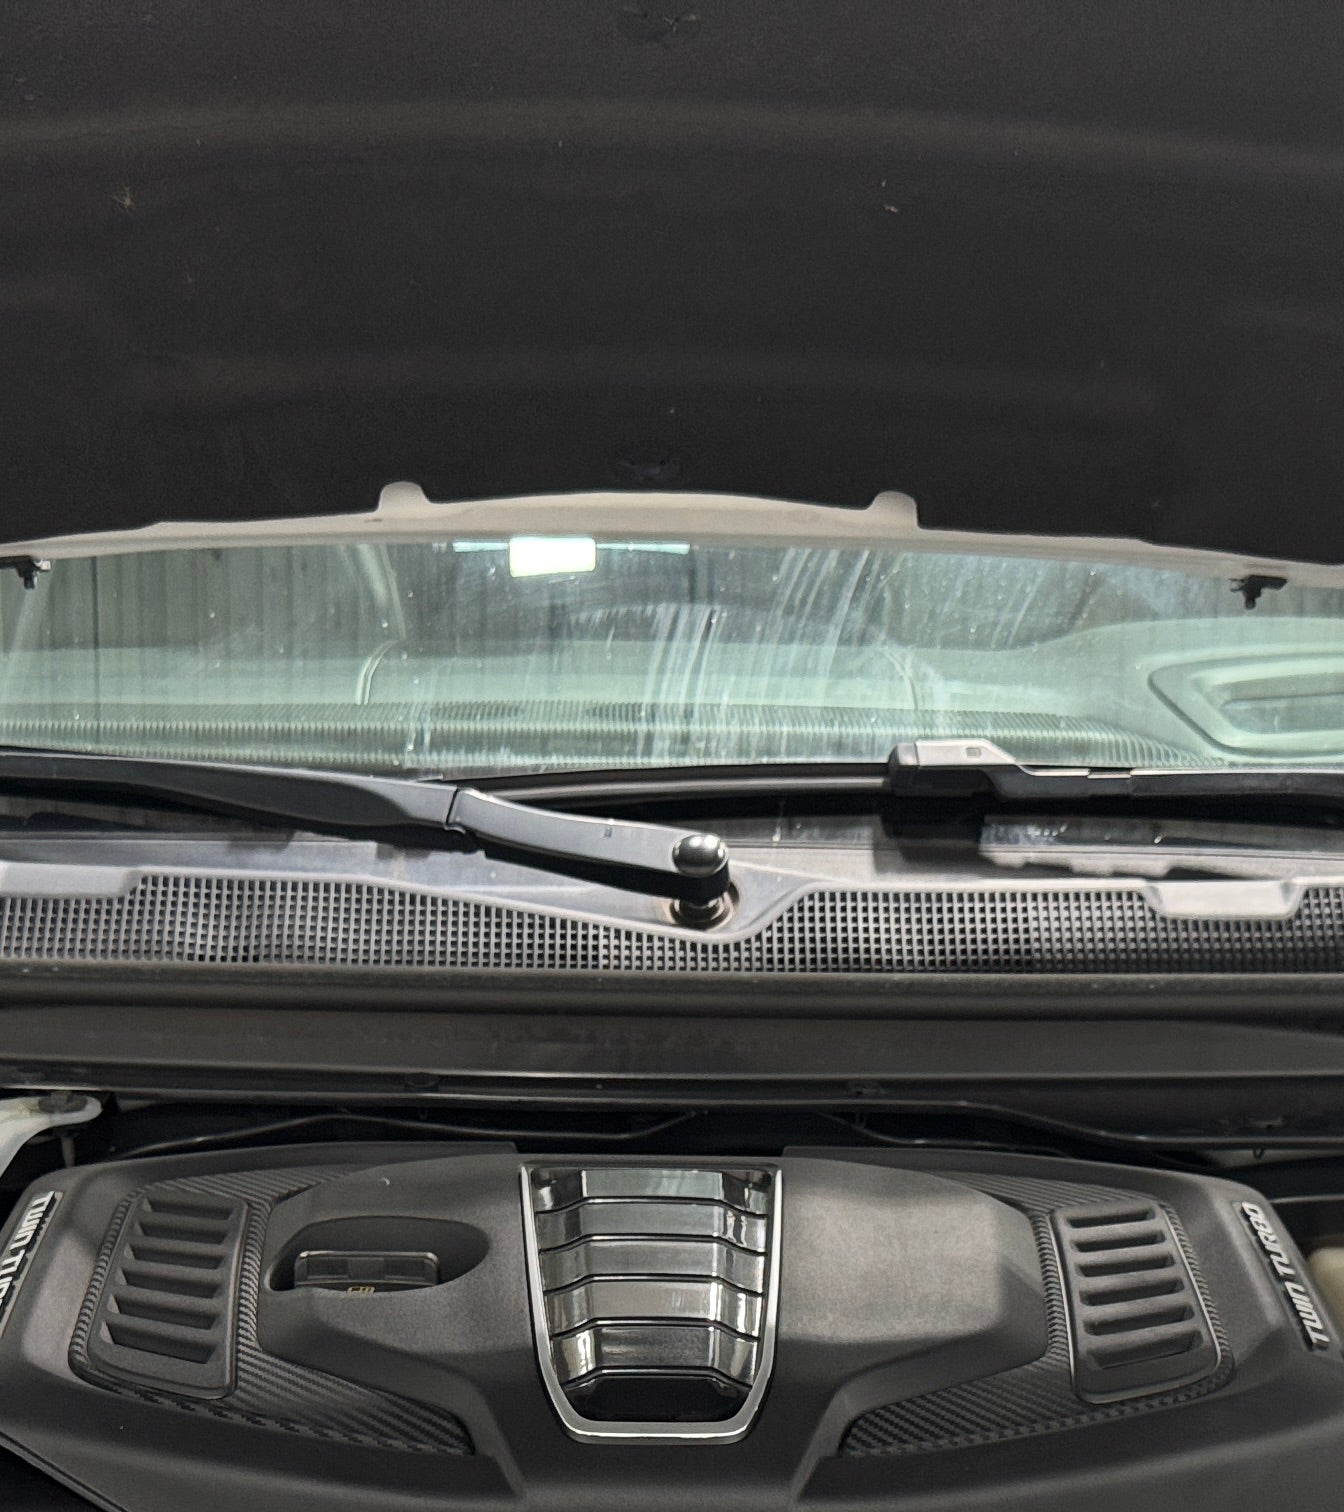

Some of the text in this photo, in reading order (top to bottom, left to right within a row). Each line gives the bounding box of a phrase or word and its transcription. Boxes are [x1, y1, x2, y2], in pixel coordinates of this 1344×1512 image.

[9, 1190, 55, 1251] TWIN
[1242, 1202, 1330, 1343] TWIN TURBO
